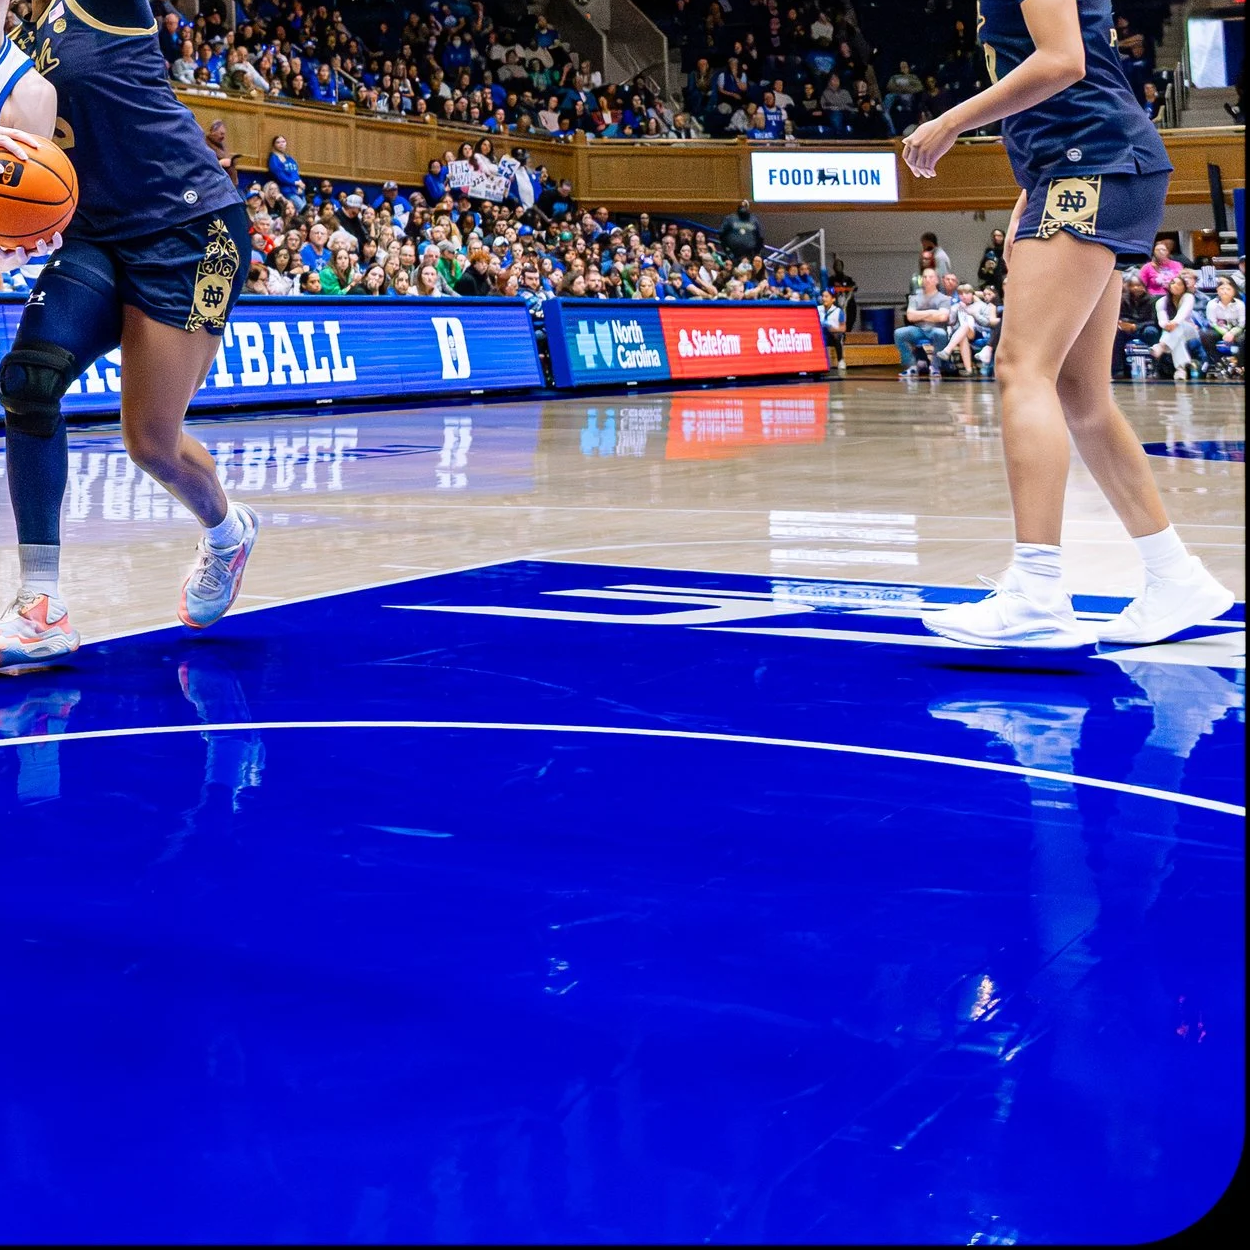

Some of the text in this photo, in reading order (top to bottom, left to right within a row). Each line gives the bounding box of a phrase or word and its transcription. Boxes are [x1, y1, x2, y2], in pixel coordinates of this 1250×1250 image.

[769, 168, 880, 185] FOOD LION
[611, 320, 644, 344] North
[617, 343, 661, 369] Carolina
